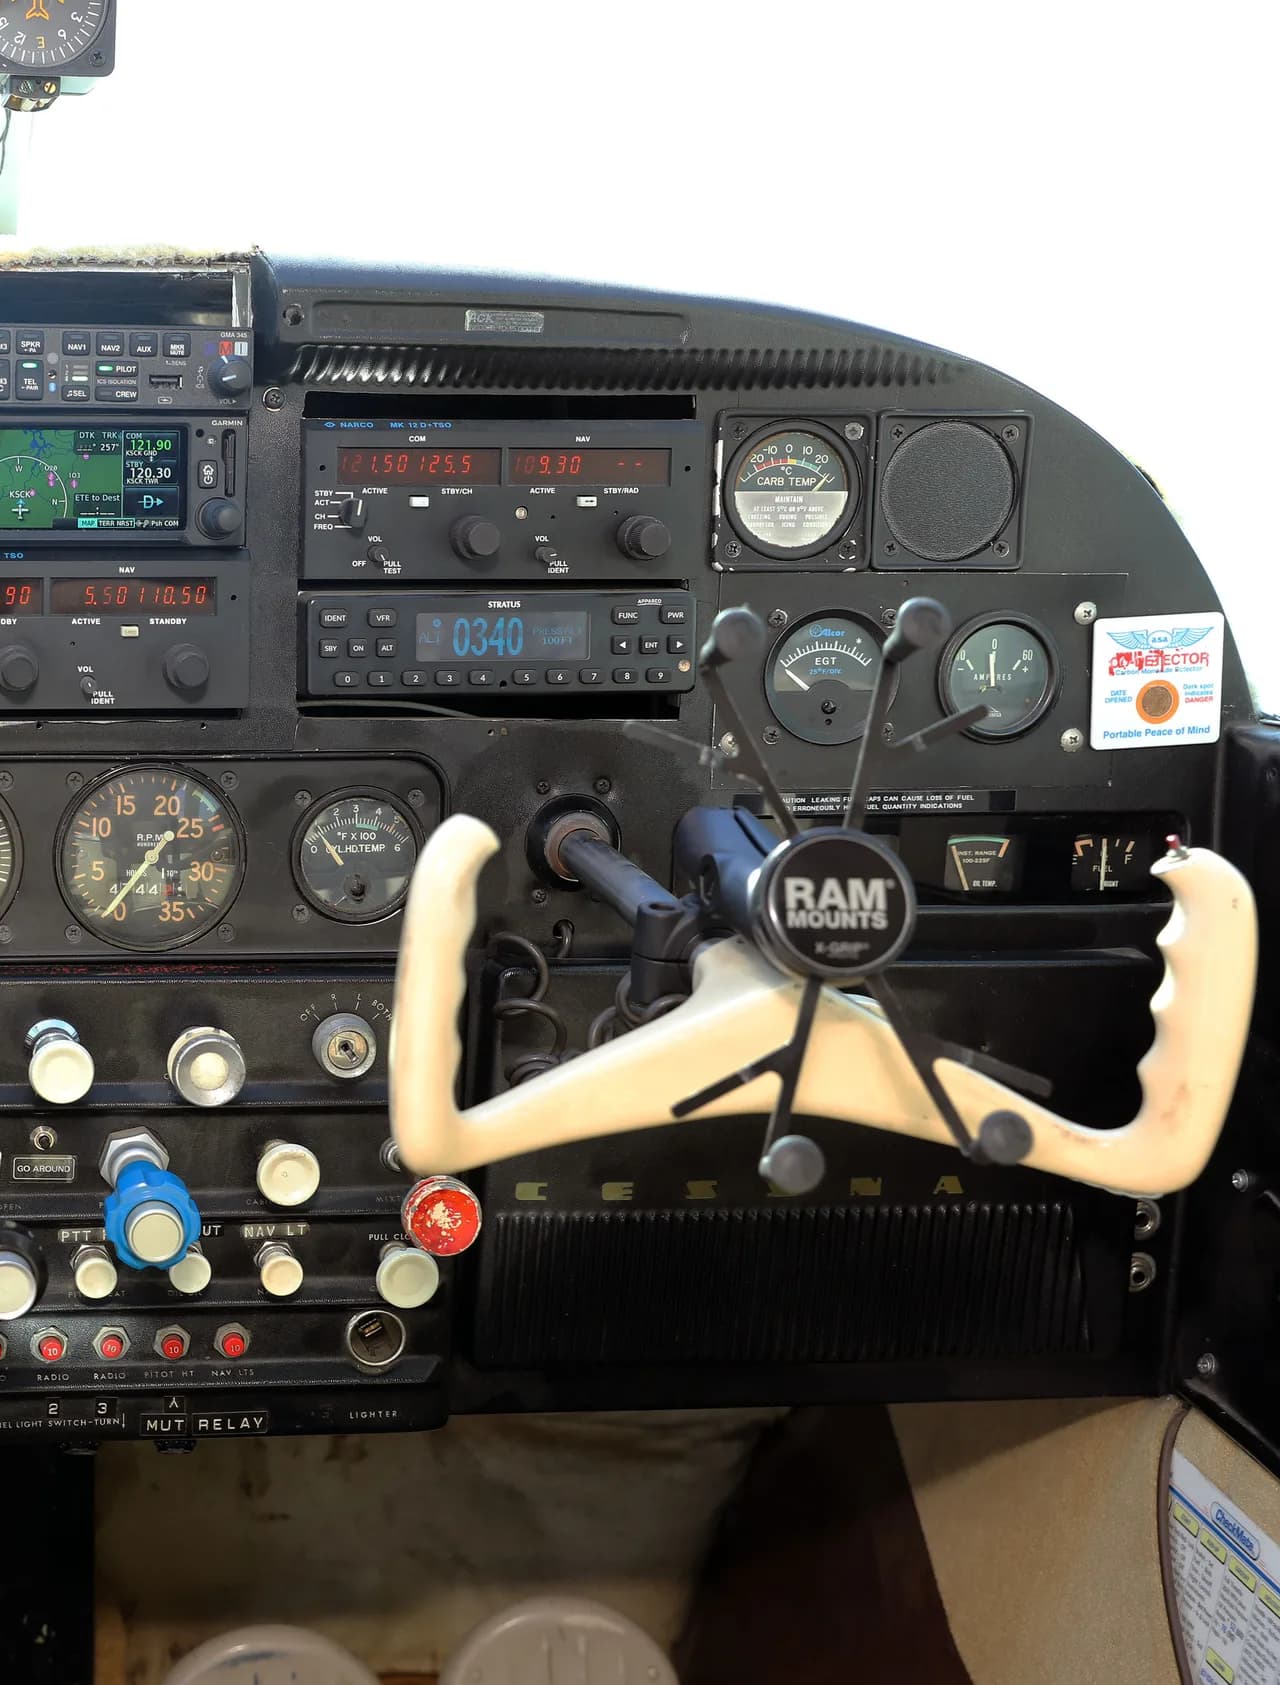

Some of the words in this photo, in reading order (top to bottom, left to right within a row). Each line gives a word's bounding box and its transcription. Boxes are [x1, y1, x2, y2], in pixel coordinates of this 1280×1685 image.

[131, 440, 172, 451] 121.90
[130, 468, 171, 478] 120.30
[757, 477, 785, 486] CARB
[789, 477, 817, 486] TEMP
[452, 617, 522, 656] 0340
[820, 627, 846, 638] Alcor
[815, 657, 836, 666] EGT
[1103, 728, 1142, 739] Portable
[1145, 727, 1174, 736] Peace
[1176, 727, 1185, 735] of
[1188, 725, 1210, 734] Mind
[117, 796, 135, 815] 15
[154, 796, 180, 815] 20
[92, 817, 111, 836] 10
[177, 818, 203, 837] 25
[189, 862, 213, 880] 30
[159, 902, 184, 921] 35
[786, 910, 888, 929] MOUNTS
[17, 1165, 30, 1174] GO
[33, 1164, 71, 1173] AROUND
[244, 1225, 276, 1237] NAV
[288, 1225, 307, 1236] LT
[37, 1374, 69, 1382] RADIO
[349, 1410, 397, 1419] LIGHTER
[15, 1420, 43, 1428] LIGHT
[48, 1418, 120, 1427] SWITCH-TURN
[146, 1419, 185, 1432] MUT
[198, 1416, 262, 1431] RELAY
